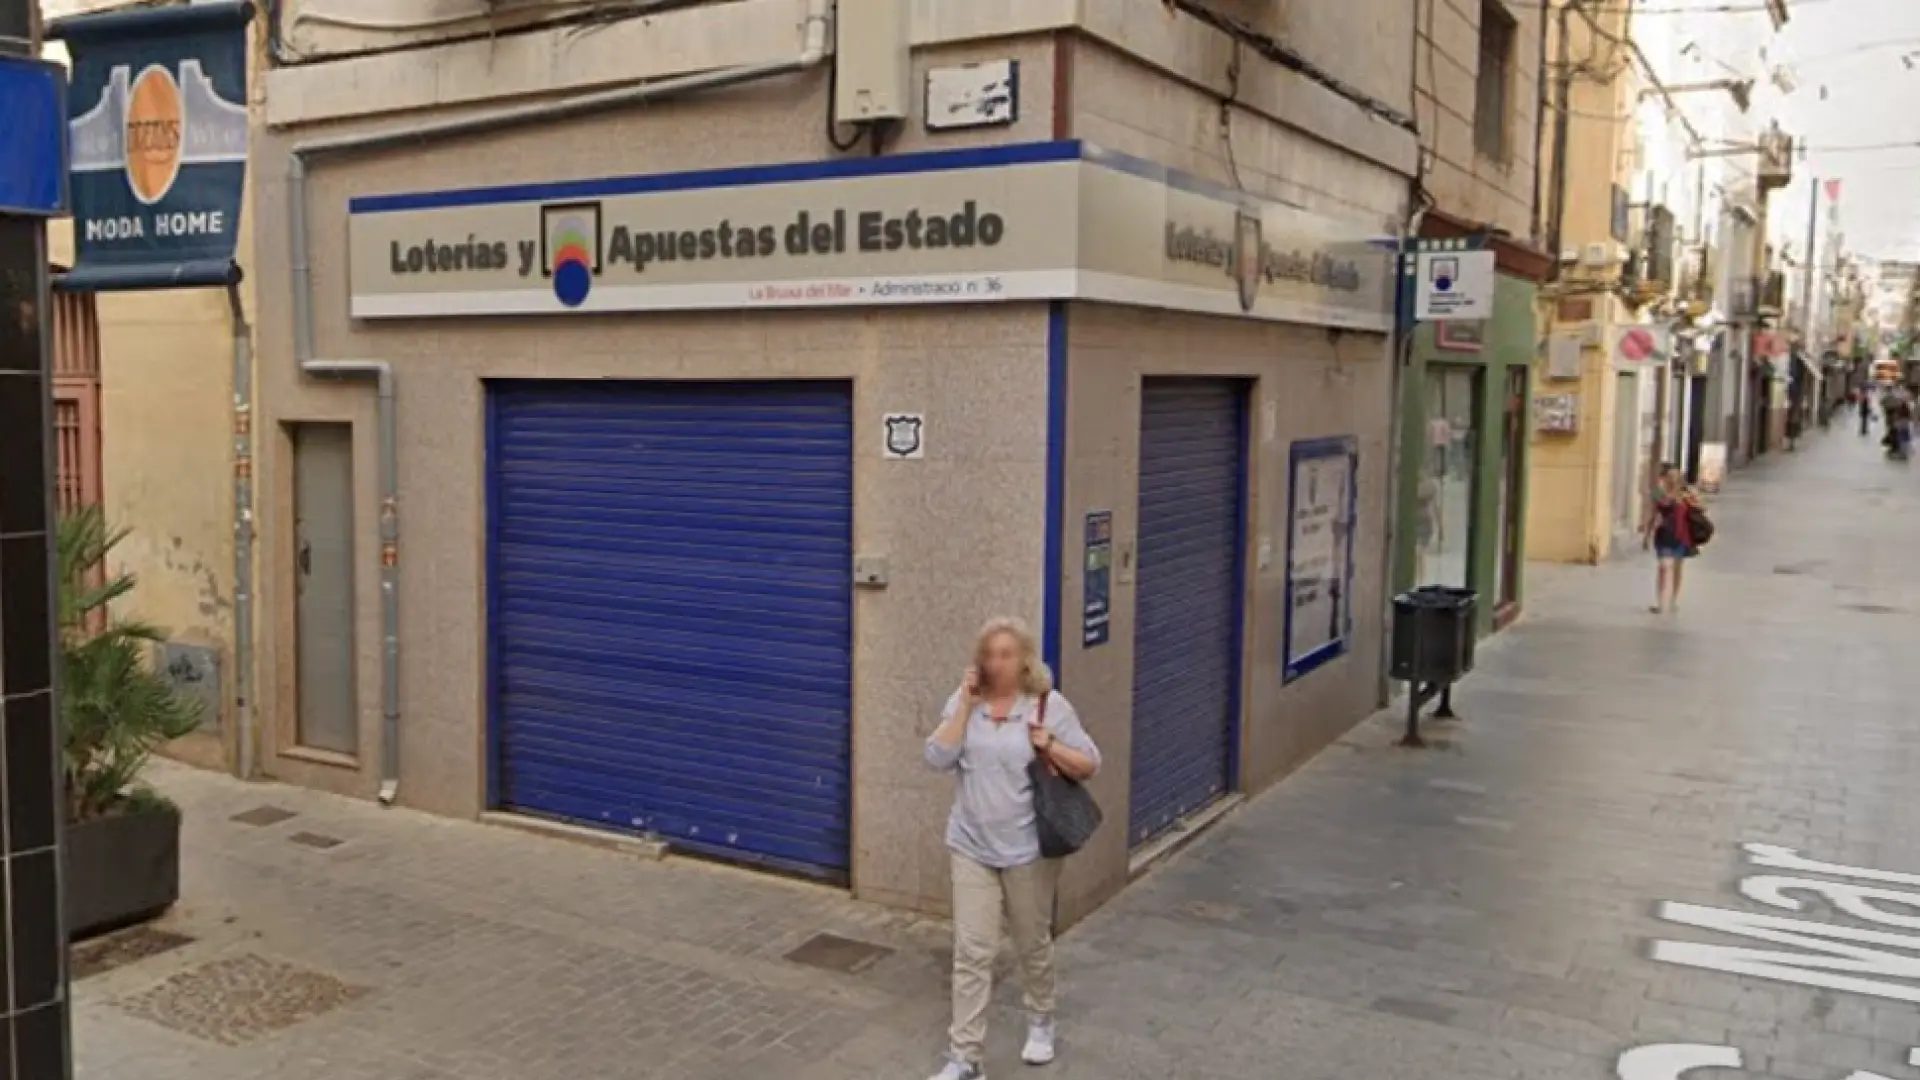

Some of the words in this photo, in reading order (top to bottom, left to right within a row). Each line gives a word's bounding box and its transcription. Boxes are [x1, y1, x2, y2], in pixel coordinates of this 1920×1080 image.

[85, 216, 144, 241] MODA
[155, 211, 224, 236] HOME
[390, 234, 507, 274] Loterías
[517, 240, 535, 277] y
[607, 219, 776, 273] Apuestas
[784, 209, 847, 255] del
[858, 201, 1004, 252] Estado
